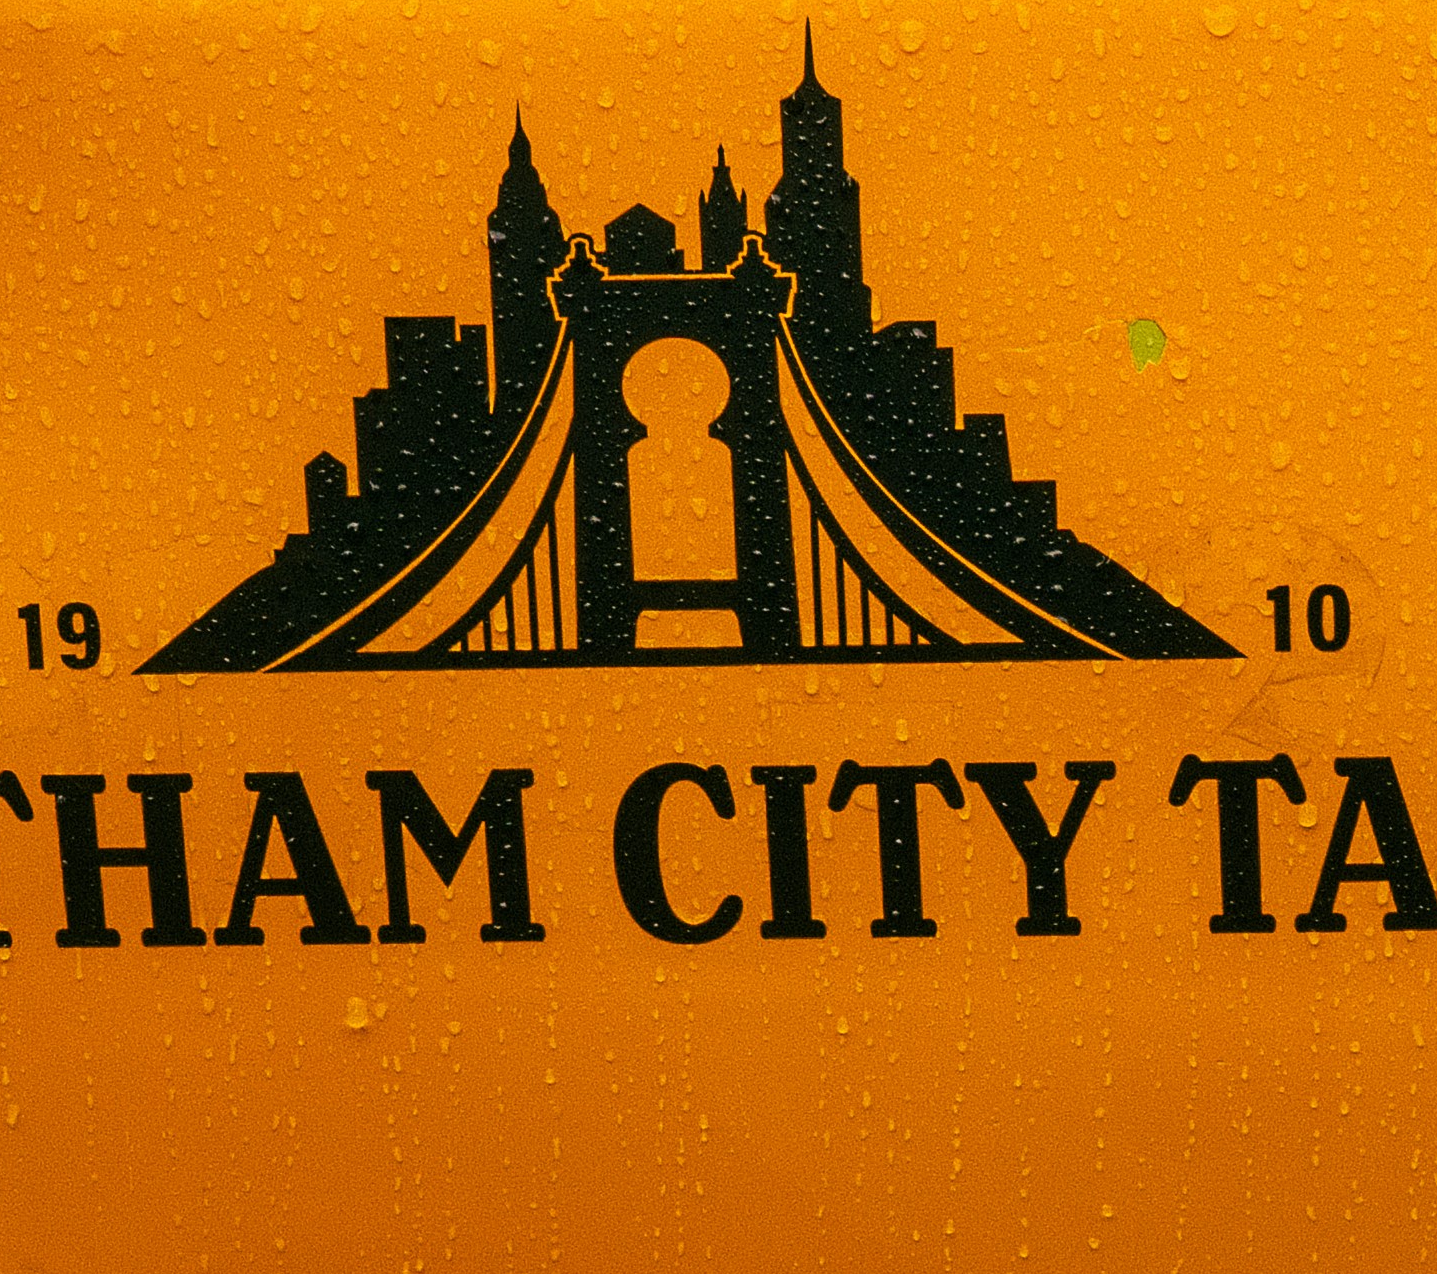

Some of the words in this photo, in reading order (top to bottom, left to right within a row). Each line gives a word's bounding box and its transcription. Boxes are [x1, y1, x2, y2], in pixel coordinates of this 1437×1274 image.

[18, 602, 101, 670] 19
[1266, 584, 1351, 652] 10
[613, 758, 1117, 945] CITY
